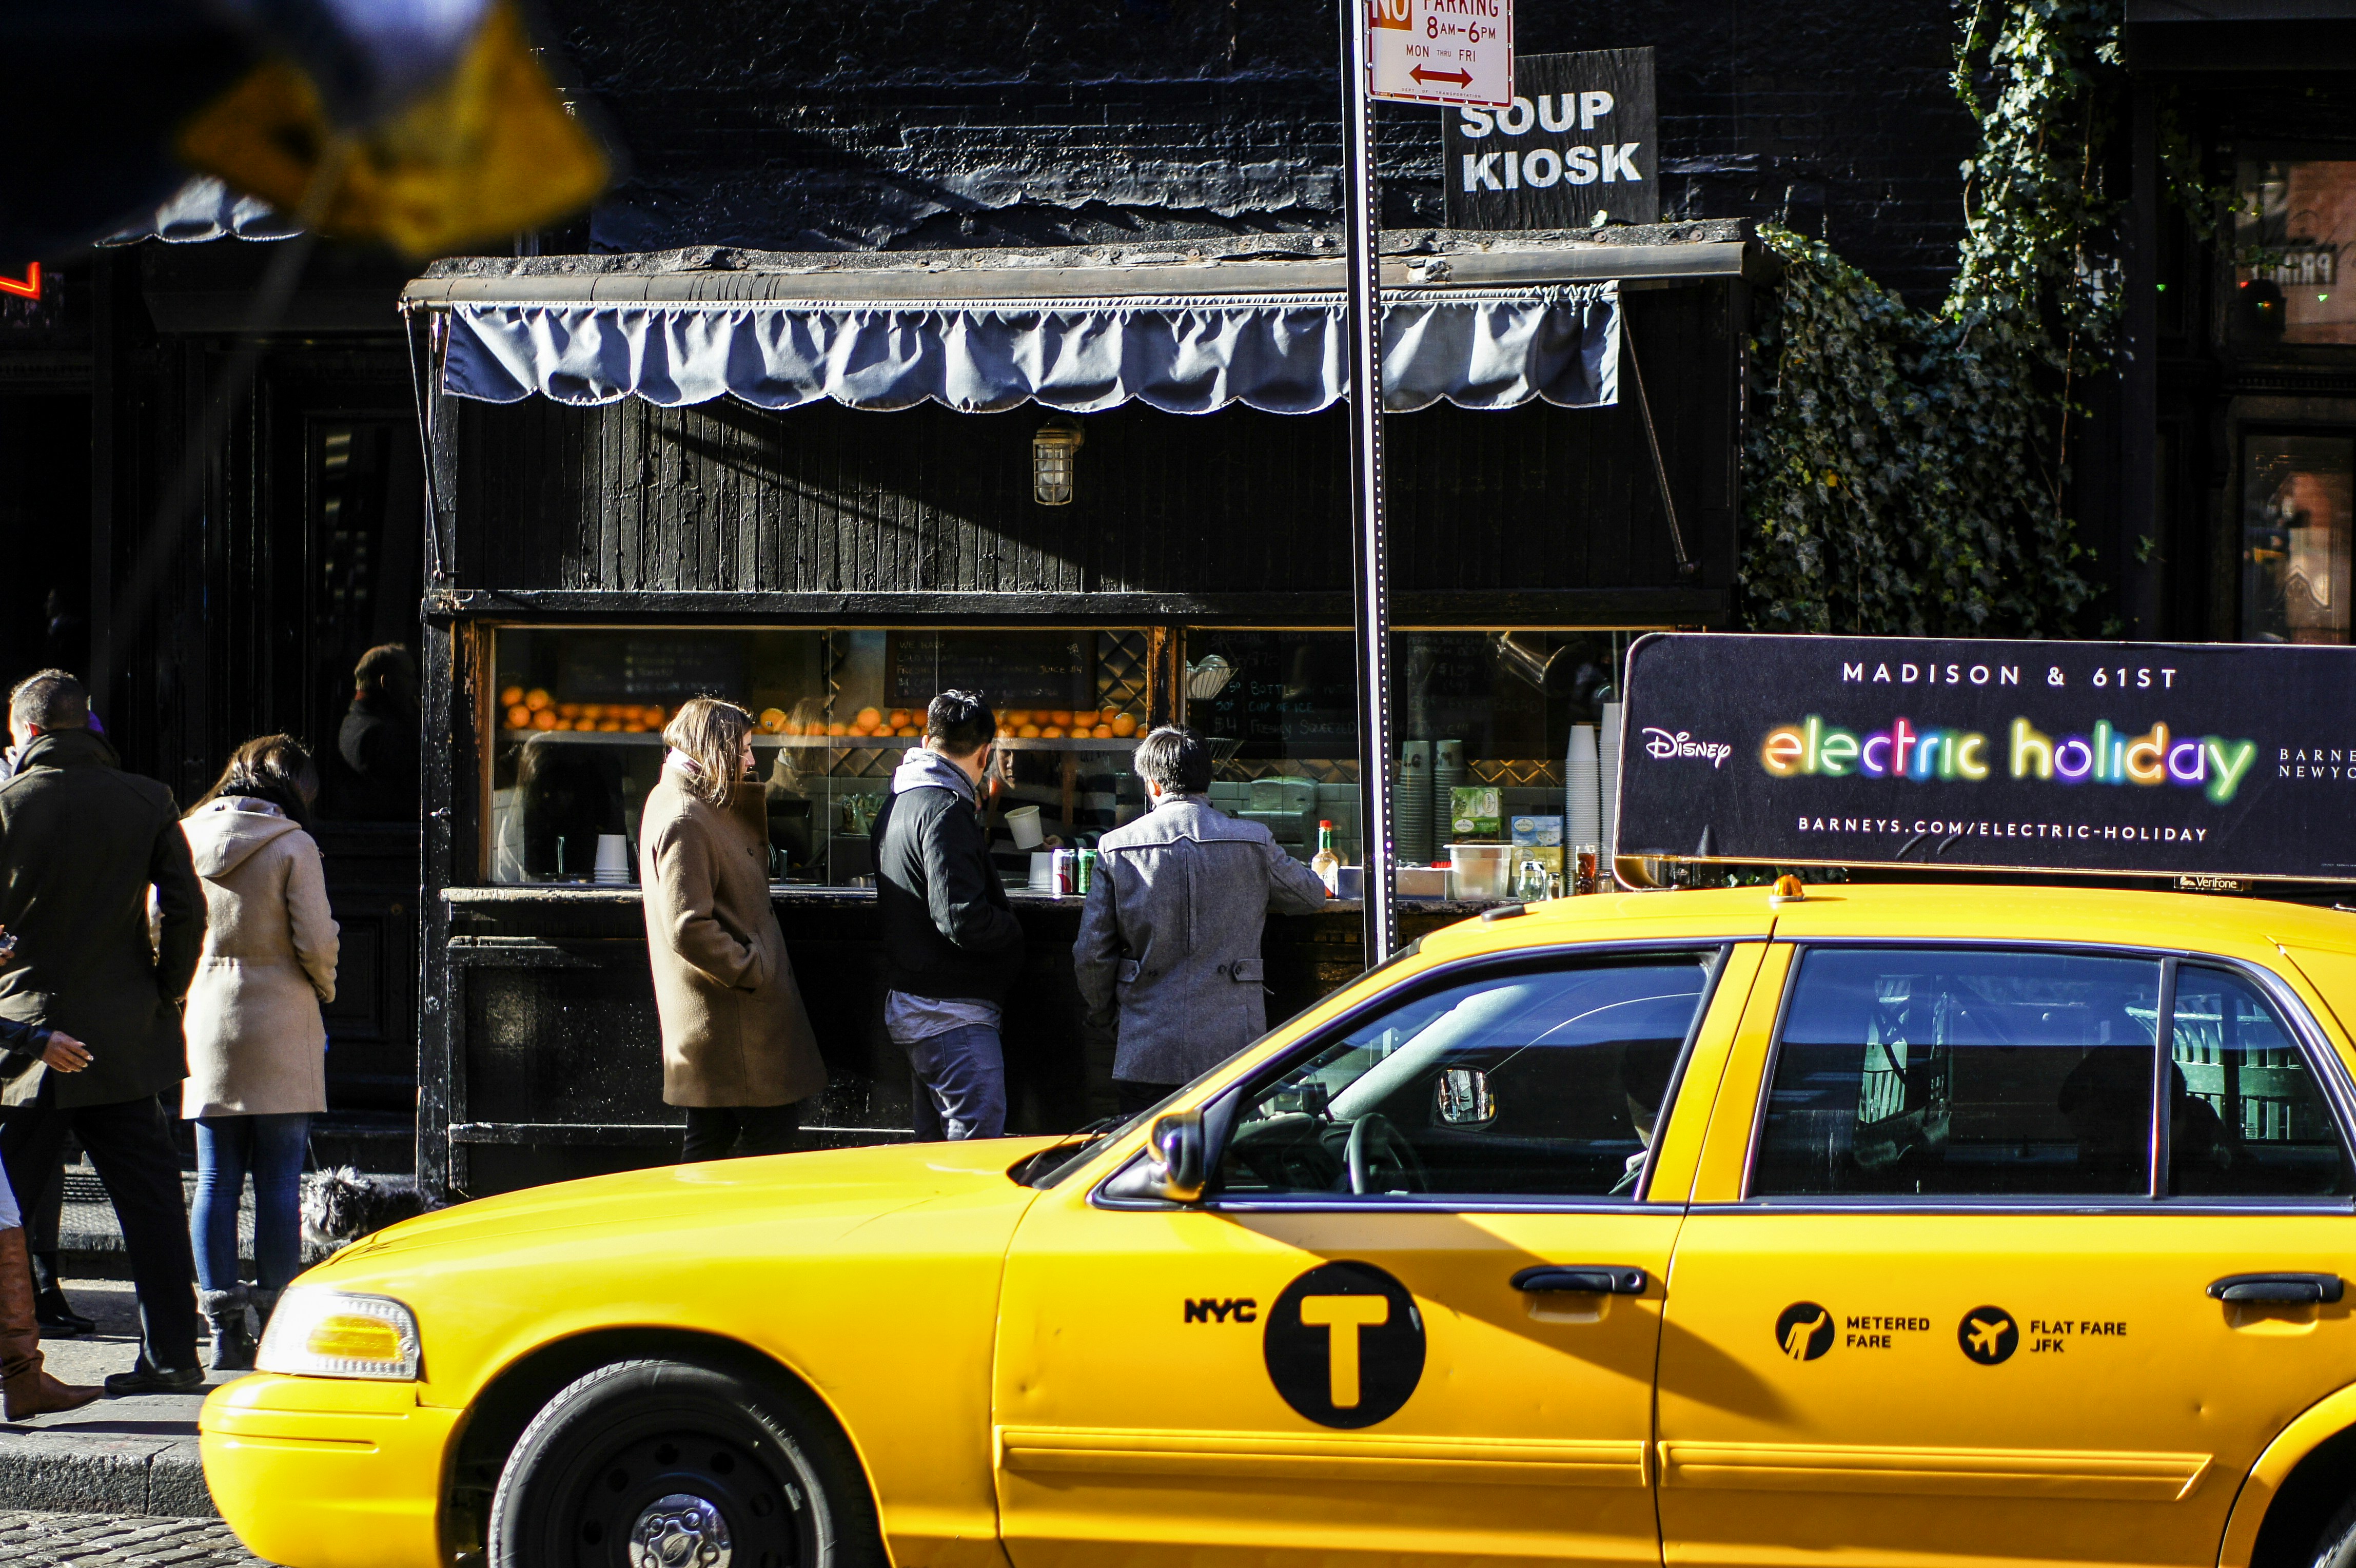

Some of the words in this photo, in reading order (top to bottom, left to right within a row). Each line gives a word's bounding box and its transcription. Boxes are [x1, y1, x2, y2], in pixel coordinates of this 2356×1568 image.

[1406, 44, 1429, 57] MON
[1459, 49, 1476, 62] FRI
[1460, 91, 1614, 138] SOUP
[1463, 142, 1642, 192] KIOSK
[1843, 662, 2019, 685] MADISON
[2048, 668, 2064, 686] &
[2093, 668, 2177, 688] 61ST
[1248, 701, 1271, 712] CUP
[1294, 702, 1316, 713] ICE
[1763, 716, 1988, 777] electric
[2013, 720, 2253, 799] holiday
[1799, 817, 2207, 841] BARNEYS.COM/ELECTRIC-HOLIDAY
[2196, 876, 2237, 889] VeriFone
[1184, 1298, 1257, 1323] NYC
[1847, 1316, 1930, 1332] METERED
[2030, 1320, 2074, 1335] FLAT
[2080, 1321, 2127, 1337] FARE
[1300, 1293, 1390, 1409] T
[1847, 1335, 1892, 1348] FARE
[2030, 1339, 2065, 1353] JFK
